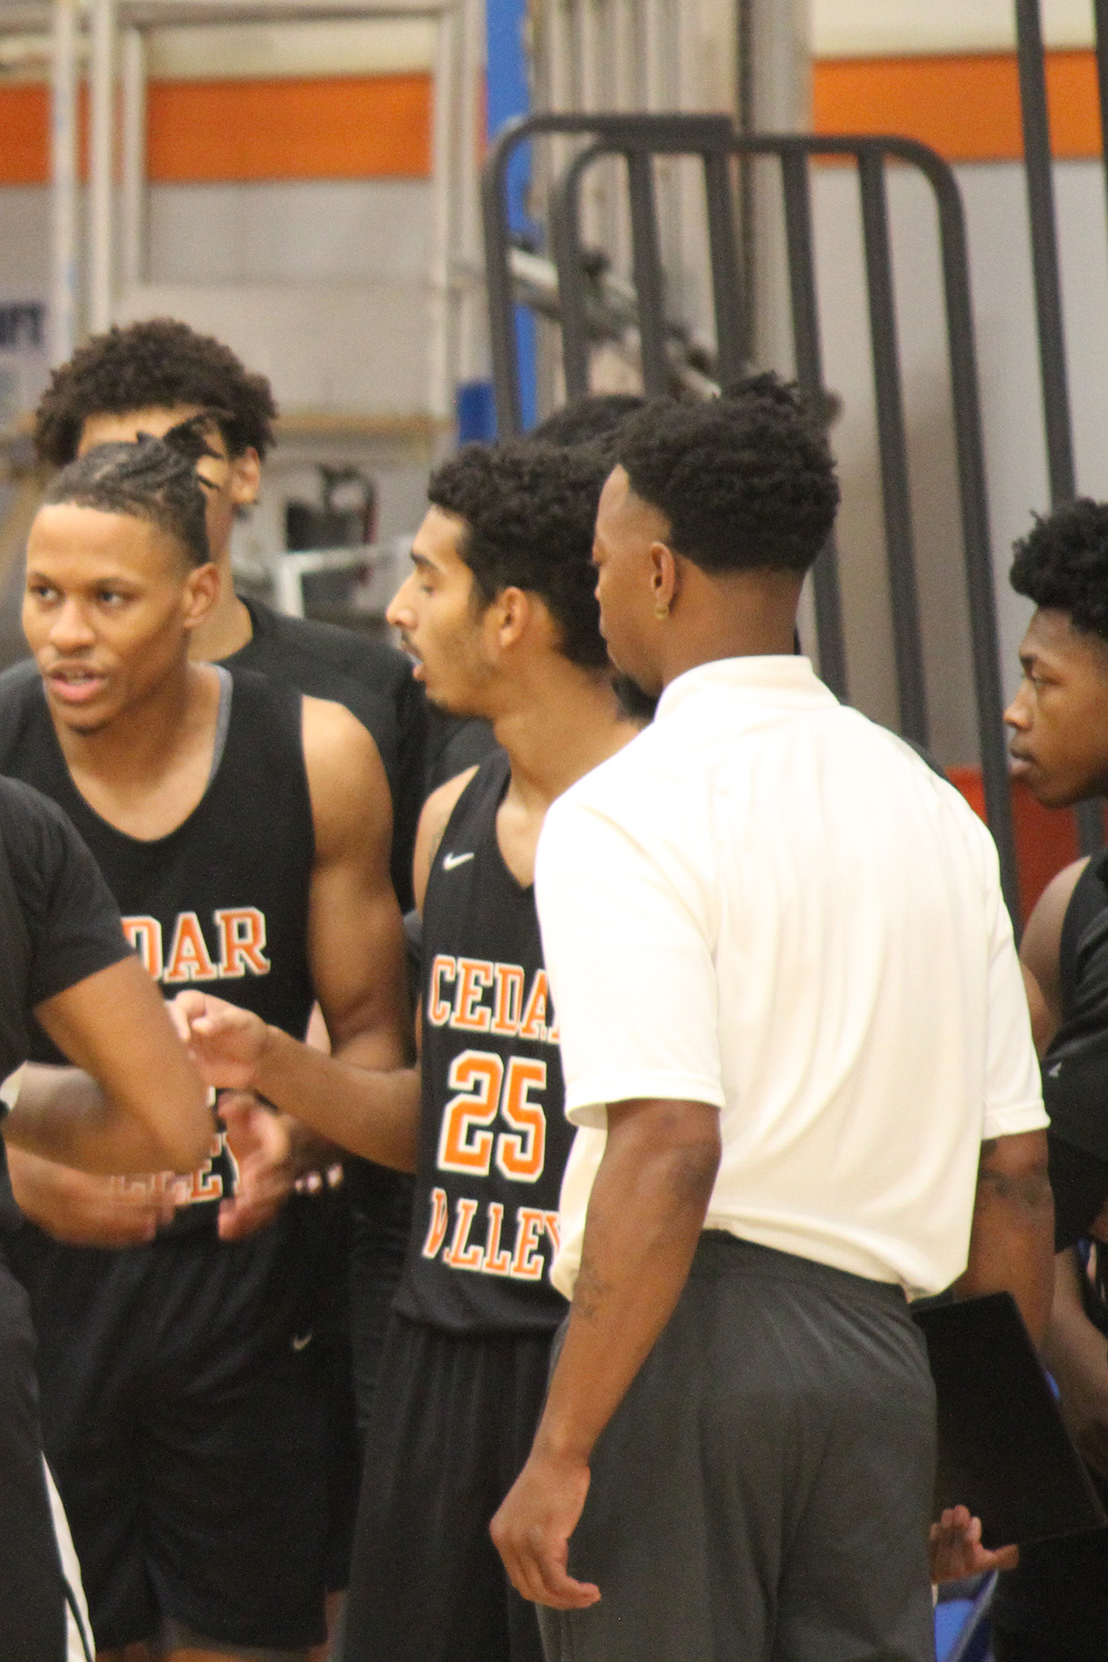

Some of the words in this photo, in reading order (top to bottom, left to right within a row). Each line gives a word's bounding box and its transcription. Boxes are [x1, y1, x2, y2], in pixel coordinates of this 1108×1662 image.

[121, 906, 272, 984] DAR
[428, 954, 561, 1044] CEDA
[437, 1050, 547, 1183] 25
